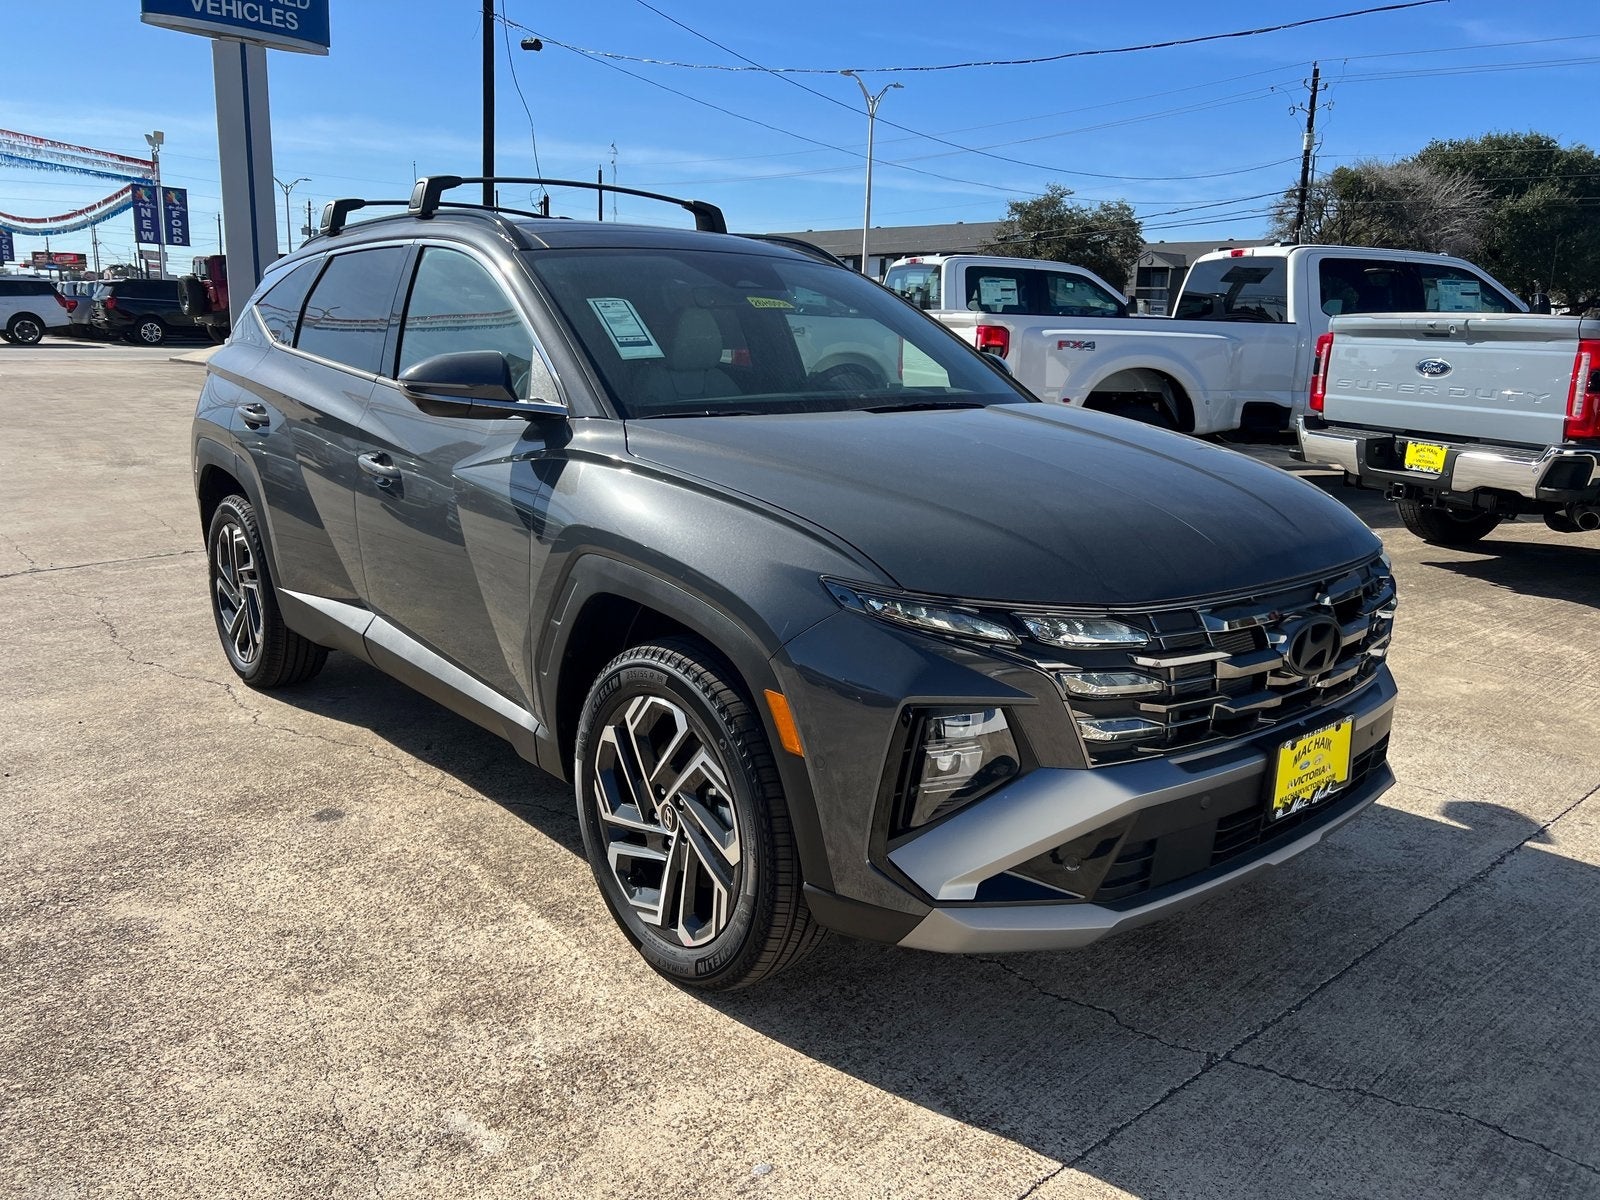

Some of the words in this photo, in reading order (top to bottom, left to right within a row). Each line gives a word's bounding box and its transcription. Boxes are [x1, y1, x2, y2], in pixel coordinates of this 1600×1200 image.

[191, 0, 299, 30] VEHICLES
[140, 207, 154, 241] NEW
[171, 210, 183, 244] FORD
[1057, 340, 1096, 351] FX4
[1336, 378, 1439, 397] SUPER
[1449, 387, 1551, 404] DUTY
[1292, 740, 1313, 768] MAC
[1314, 737, 1332, 751] HAIK
[1294, 765, 1327, 787] VICTORIA
